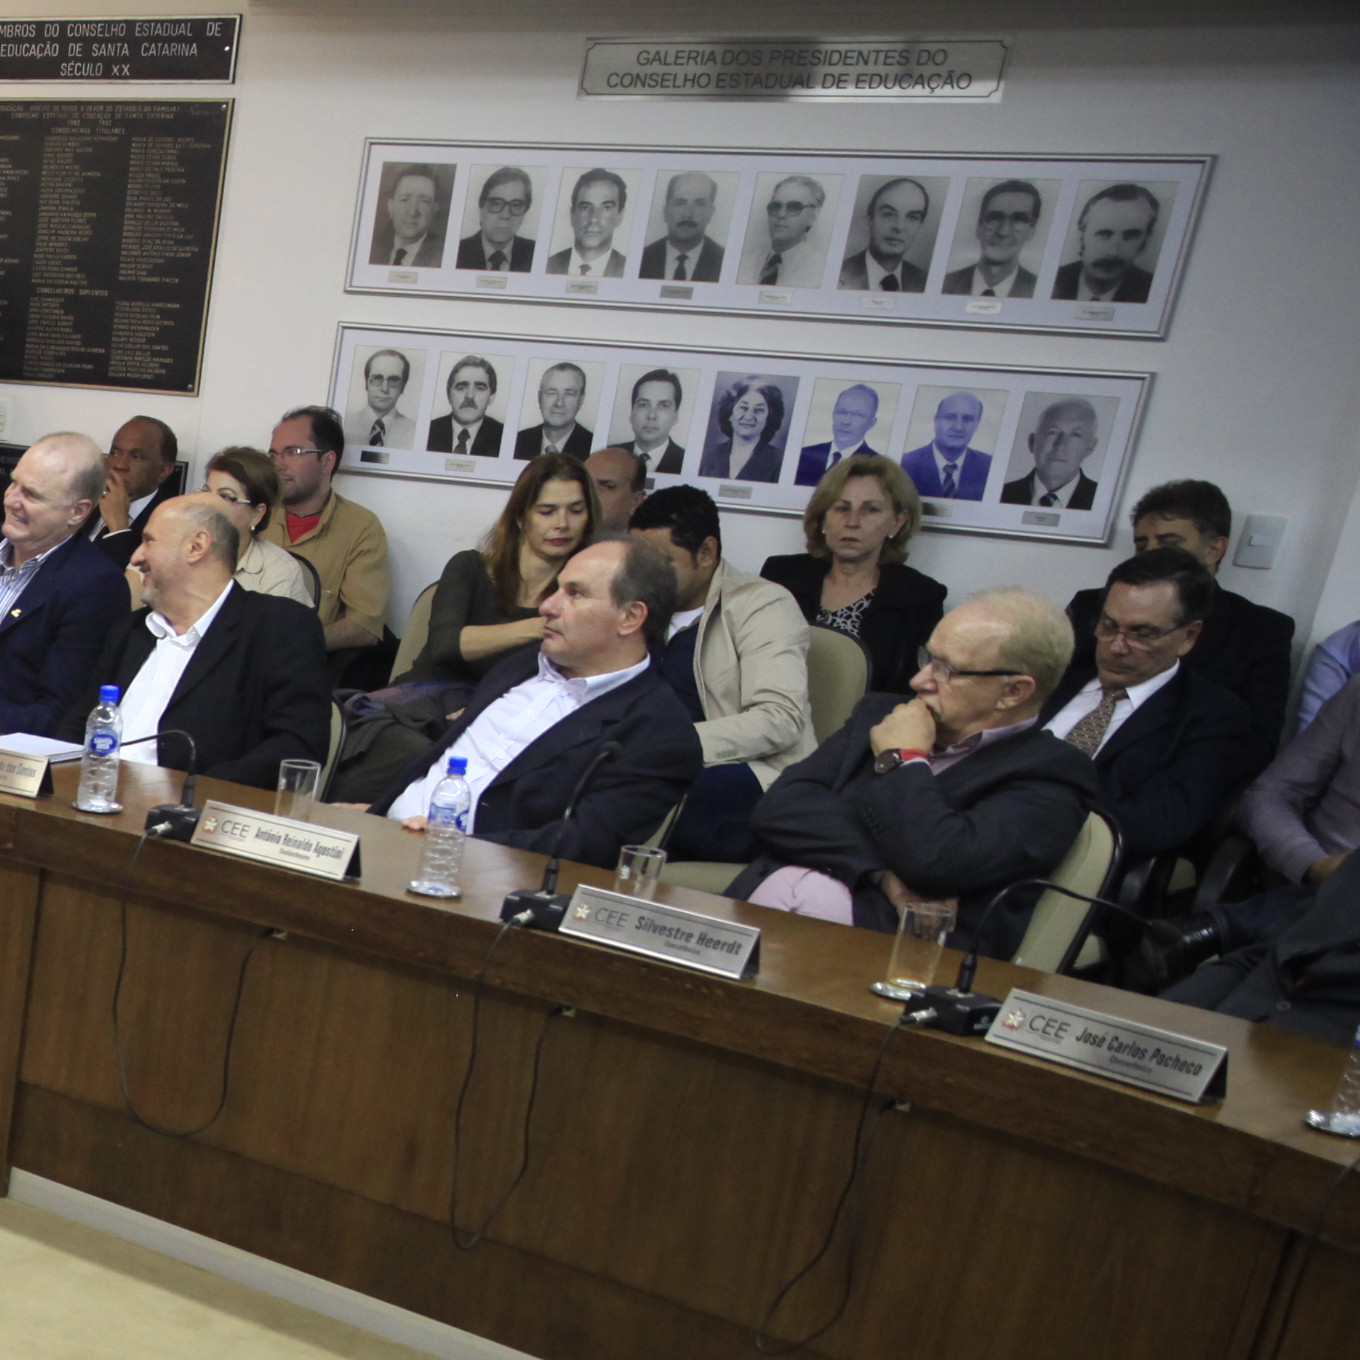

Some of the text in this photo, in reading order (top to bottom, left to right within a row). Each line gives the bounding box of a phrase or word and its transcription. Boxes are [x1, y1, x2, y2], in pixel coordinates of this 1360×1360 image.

[45, 23, 59, 37] DO
[67, 23, 126, 37] CONSELHO
[135, 22, 193, 36] ESTADUAL
[207, 22, 223, 36] DE
[0, 42, 198, 59] EDUCAÇÃO DE SANTA CATARINA
[636, 49, 948, 67] GALERIA DOS PRESIDENTES DO
[60, 61, 130, 77] SÉCULO XX
[606, 70, 972, 94] CONSELHO ESTADUAL DE EDUCAÇÃO
[221, 819, 251, 838] CEE
[282, 834, 312, 853] Reinaldo
[313, 841, 343, 860] Agostini
[594, 906, 742, 956] CEE Silvestre Heerdt
[1028, 1014, 1202, 1077] CEE José Carlos Pacheco
